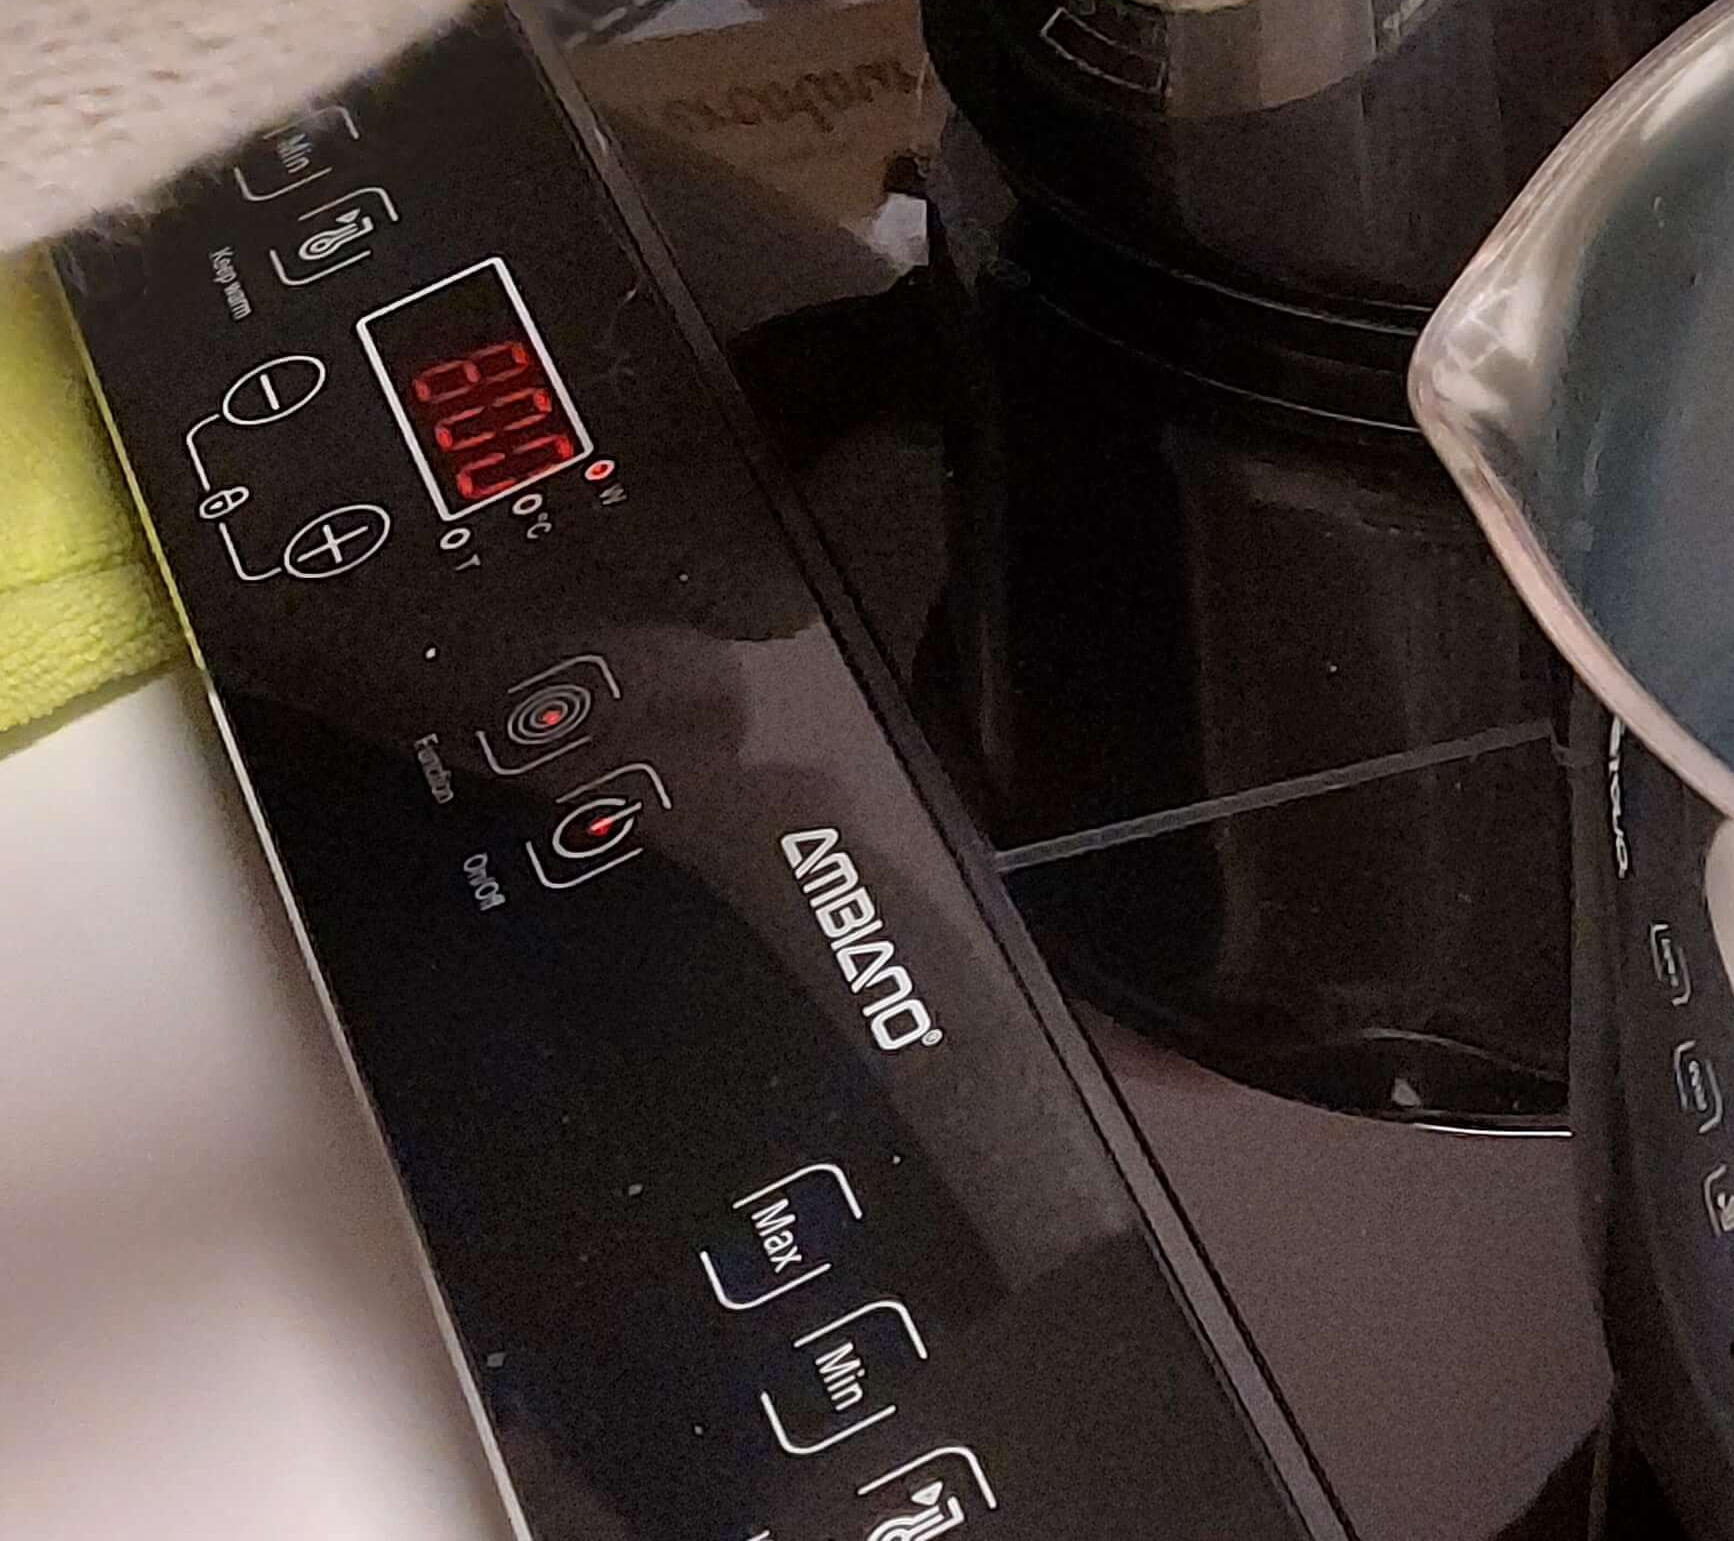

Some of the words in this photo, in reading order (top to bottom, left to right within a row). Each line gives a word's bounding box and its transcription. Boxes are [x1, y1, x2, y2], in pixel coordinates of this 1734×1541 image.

[210, 248, 235, 287] Keep
[222, 283, 252, 320] warm
[600, 485, 627, 506] W
[454, 553, 481, 572] T
[413, 732, 455, 805] Function
[780, 827, 930, 1051] AMBIANO
[750, 1199, 803, 1273] Max
[815, 1341, 864, 1411] Min
